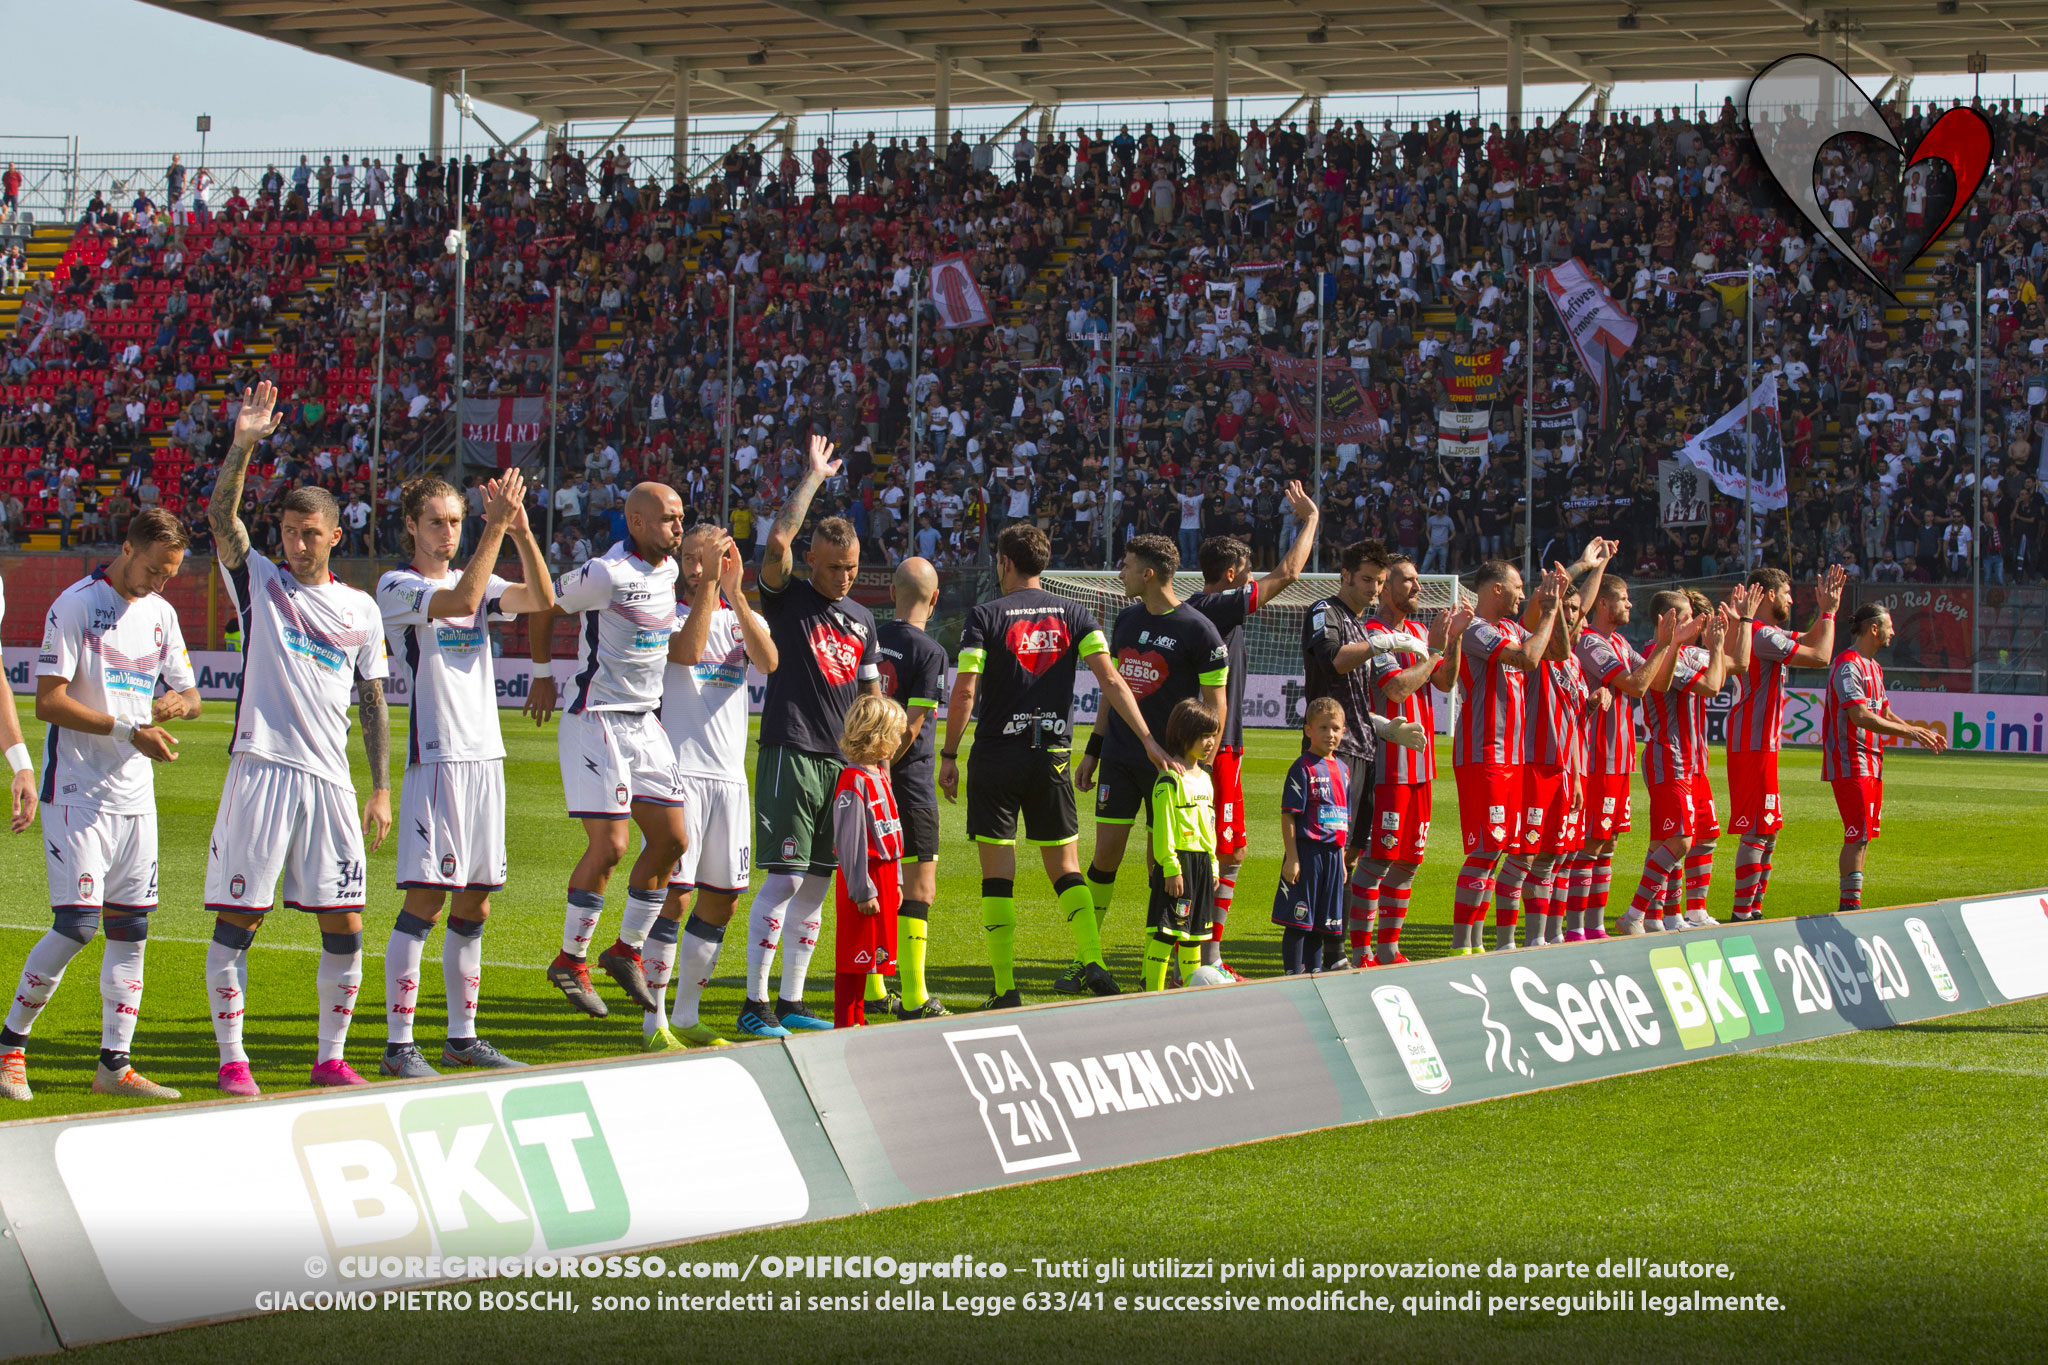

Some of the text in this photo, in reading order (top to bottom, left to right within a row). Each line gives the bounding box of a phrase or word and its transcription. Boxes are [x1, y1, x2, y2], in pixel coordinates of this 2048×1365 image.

[1455, 355, 1491, 366] PULCE
[1456, 374, 1494, 387] MIRKO
[1456, 414, 1475, 424] CHE
[626, 591, 652, 601] Zeus
[1902, 591, 1932, 607] Red
[1934, 594, 1969, 622] Grey
[639, 629, 670, 643] SanVincen
[284, 632, 342, 666] SanVincenzo
[1124, 657, 1141, 665] DONA
[105, 671, 153, 690] SanVincenzo
[1118, 663, 1160, 682] 45580
[1309, 776, 1330, 784] Zeus
[739, 846, 750, 872] 18
[336, 860, 363, 888] 34
[335, 890, 363, 899] Zeus
[1511, 934, 1911, 1063] Serie BKT 2019-20
[973, 1049, 1033, 1095] DA
[1049, 1037, 1256, 1119] DAZN.COM
[998, 1099, 1054, 1147] ZN
[302, 1111, 596, 1248] BKT
